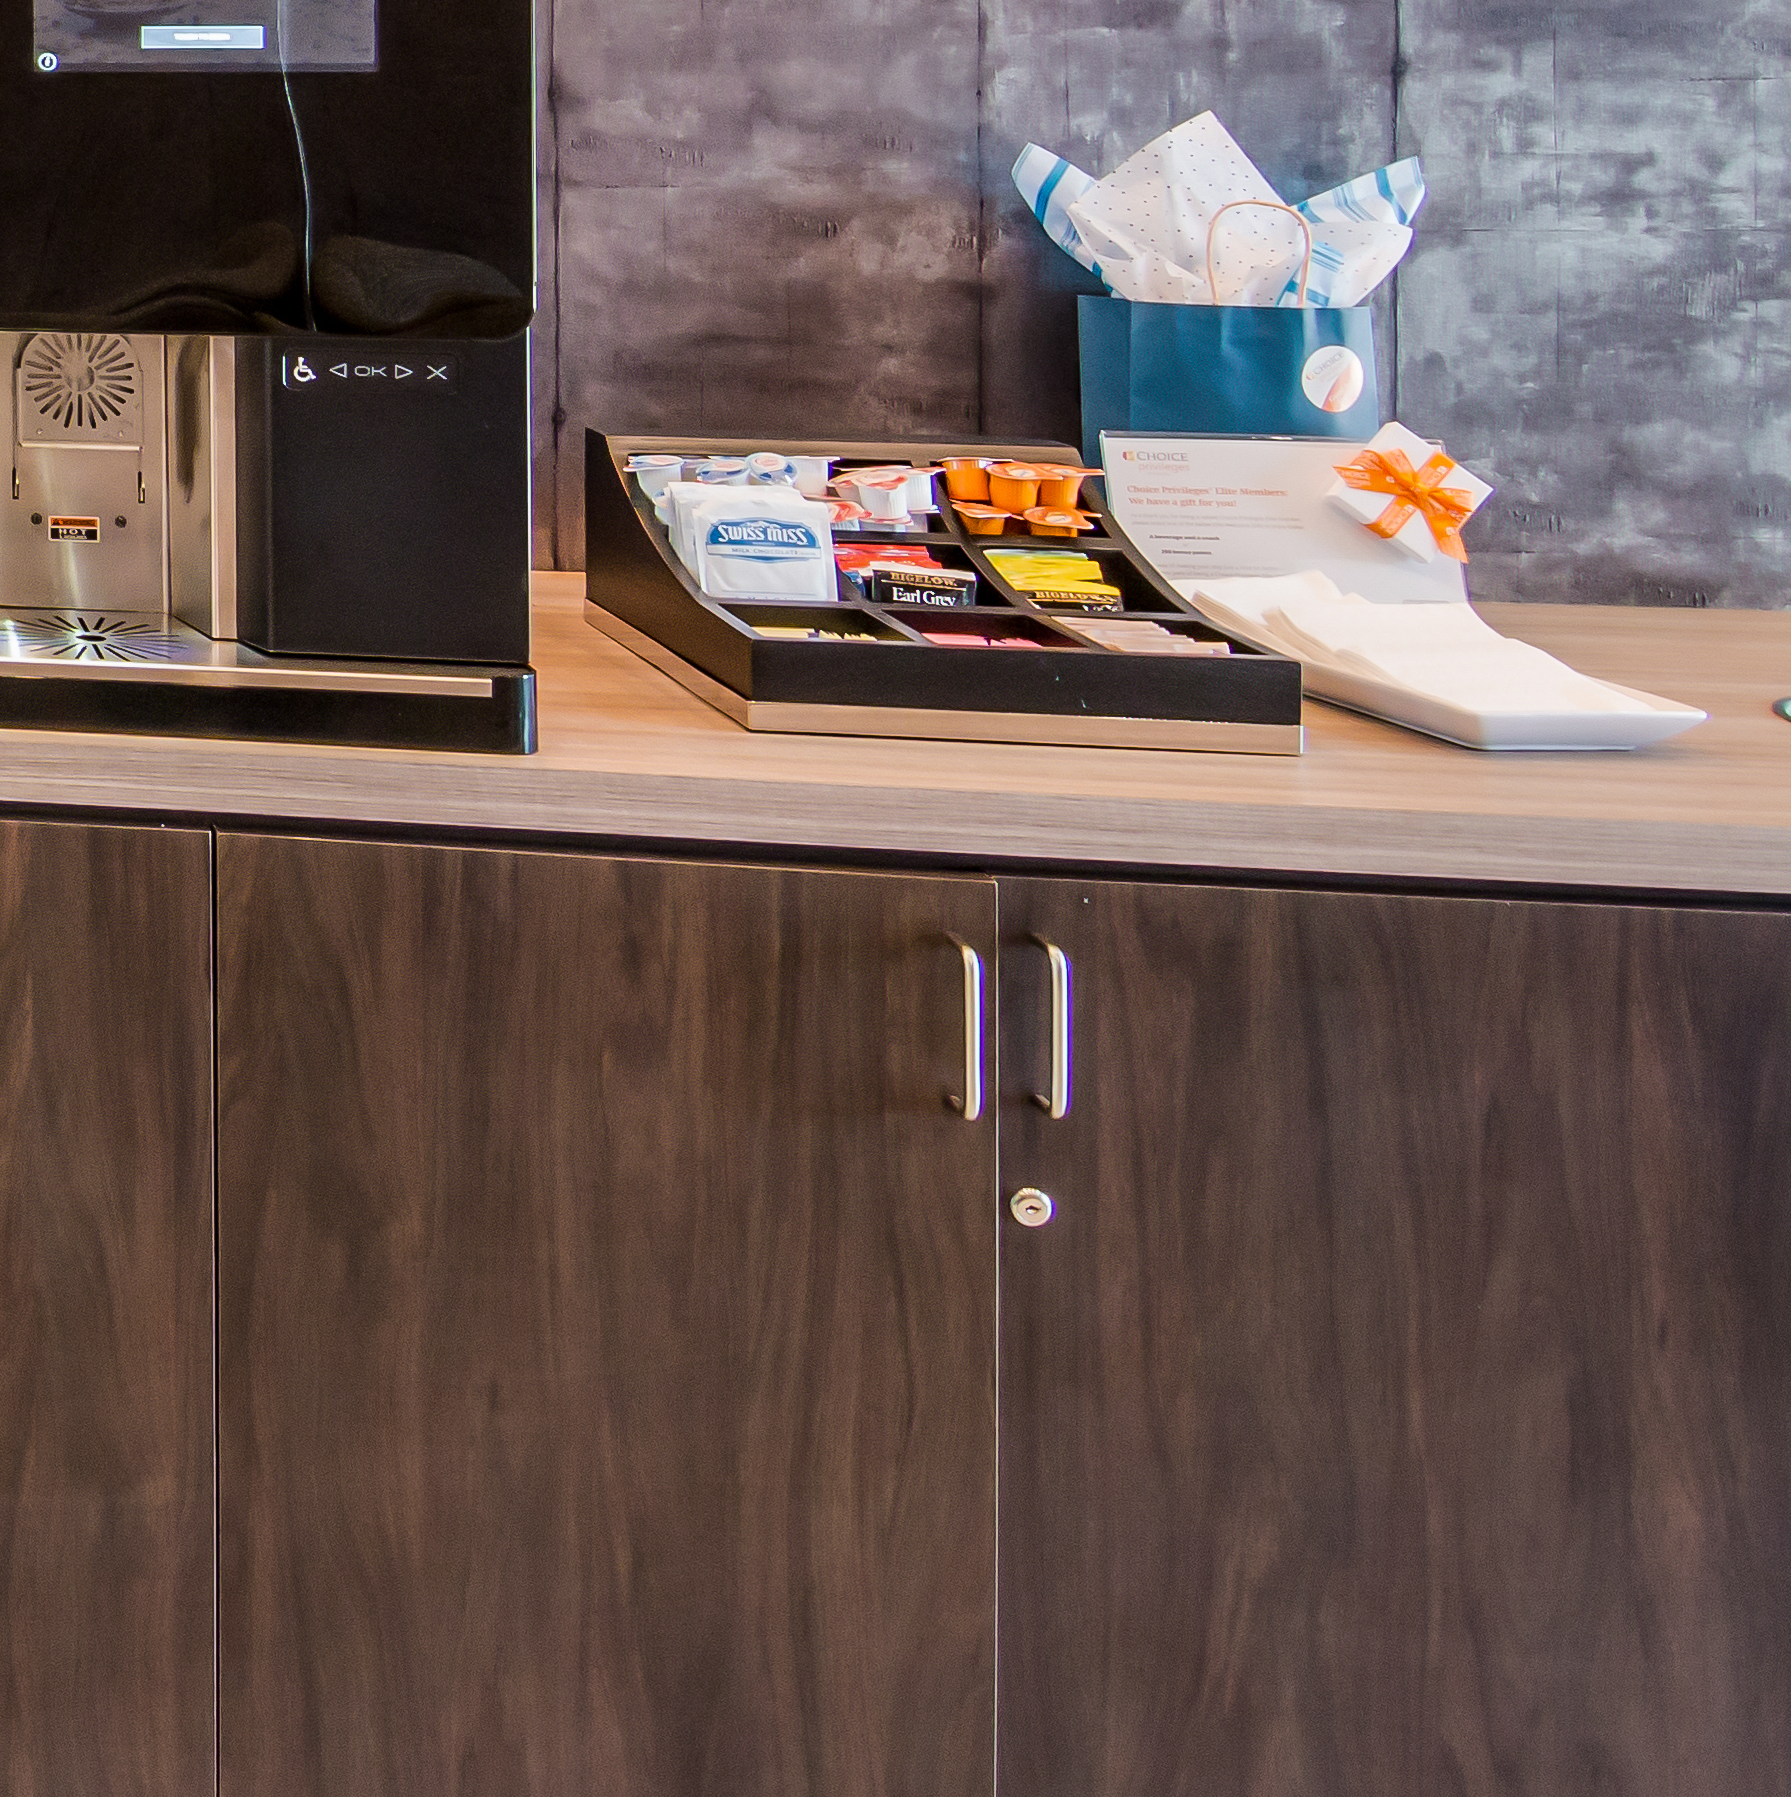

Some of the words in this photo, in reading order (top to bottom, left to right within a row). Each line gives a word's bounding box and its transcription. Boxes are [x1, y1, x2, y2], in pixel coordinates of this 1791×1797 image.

[354, 365, 387, 377] OK
[1136, 451, 1189, 461] CHOICE
[1138, 462, 1190, 472] privileges
[1127, 485, 1160, 494] Choice
[1128, 497, 1144, 505] We
[1146, 497, 1170, 505] have
[1179, 498, 1197, 507] gift
[1198, 498, 1213, 506] for
[1215, 499, 1237, 508] you!
[890, 572, 957, 587] BIGELOW
[892, 586, 921, 604] Earl
[922, 590, 957, 607] Grey
